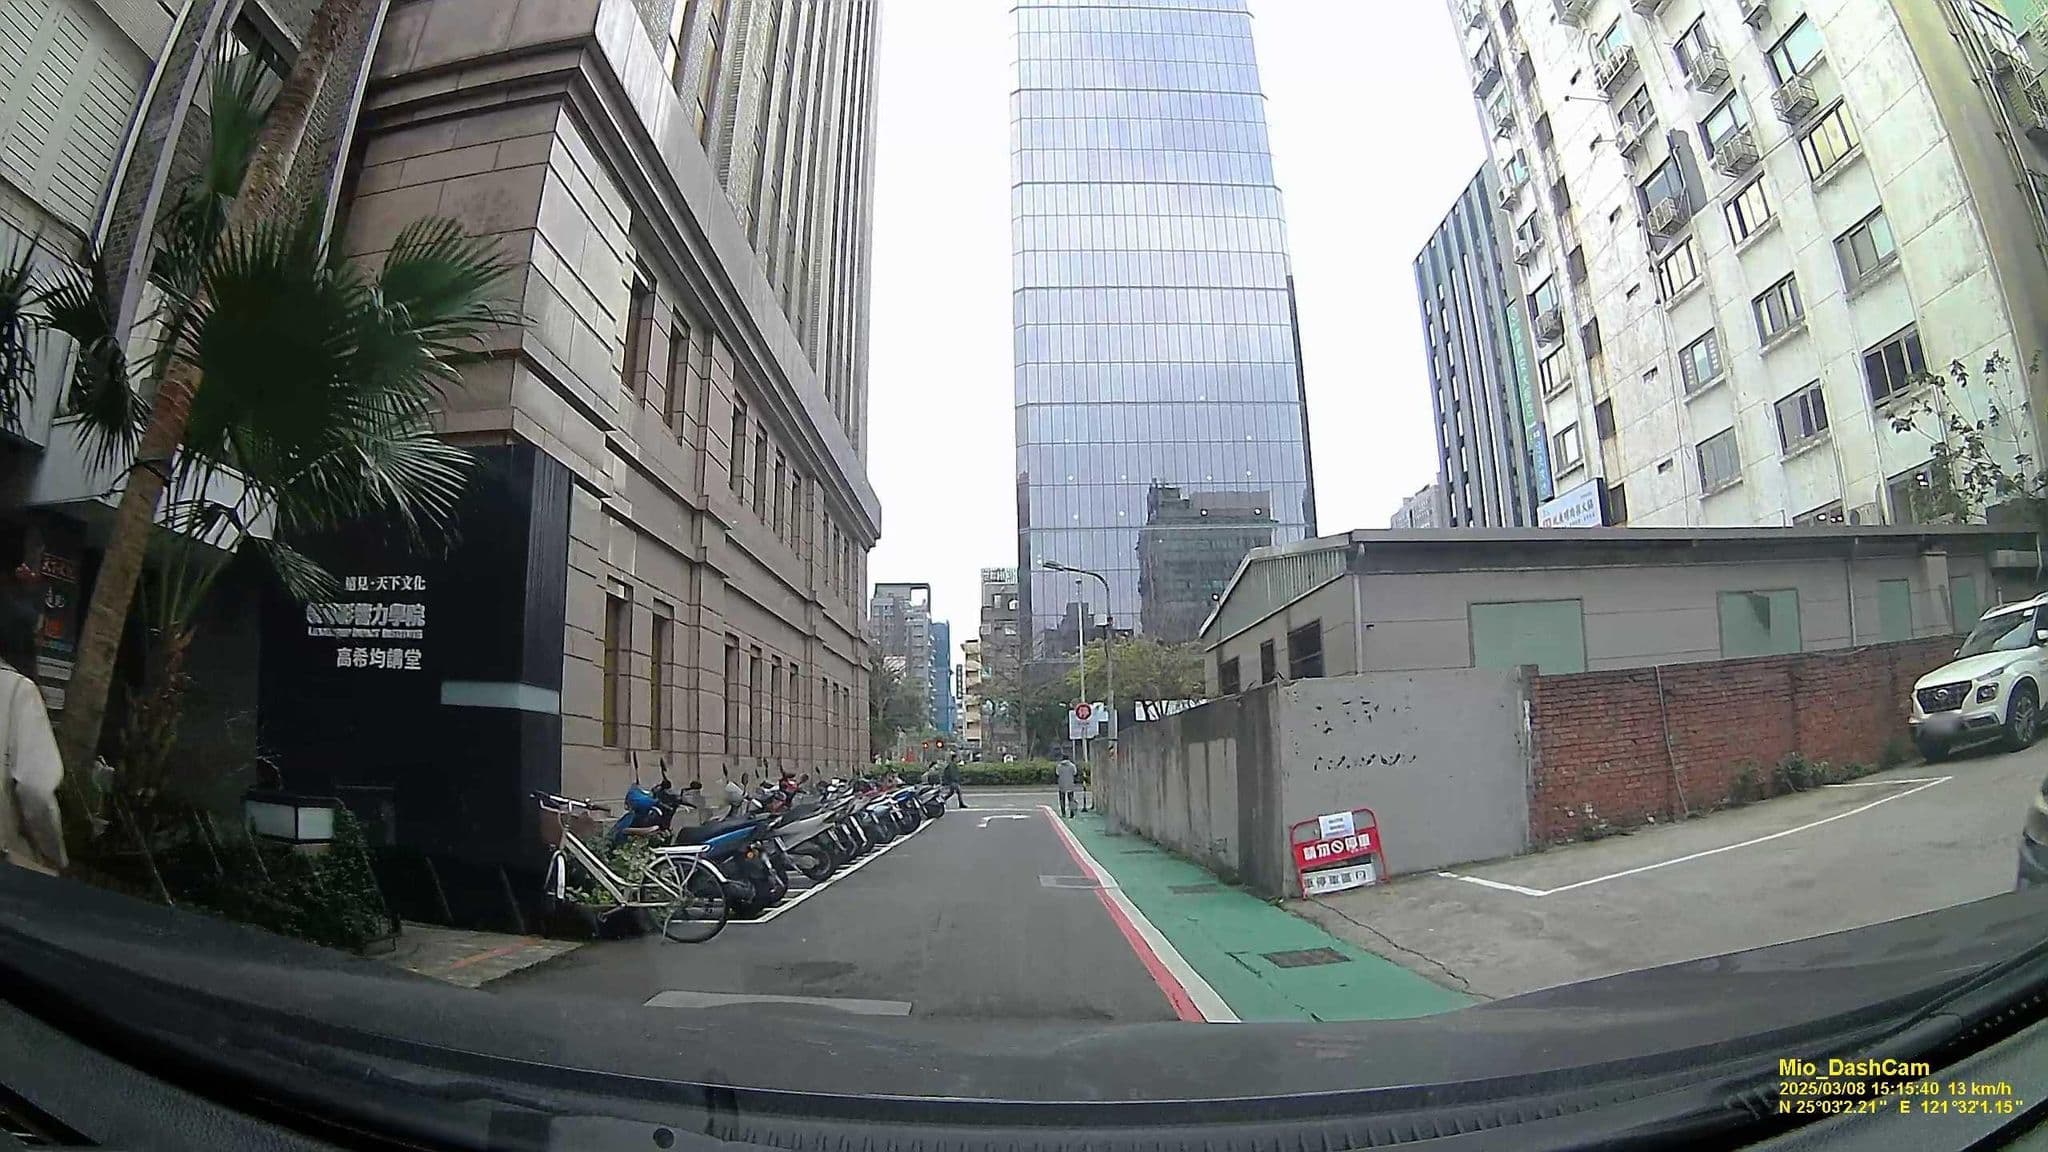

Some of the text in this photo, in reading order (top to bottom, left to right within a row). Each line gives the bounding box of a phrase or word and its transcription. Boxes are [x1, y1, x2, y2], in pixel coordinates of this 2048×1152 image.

[336, 647, 422, 670] 高希均講堂
